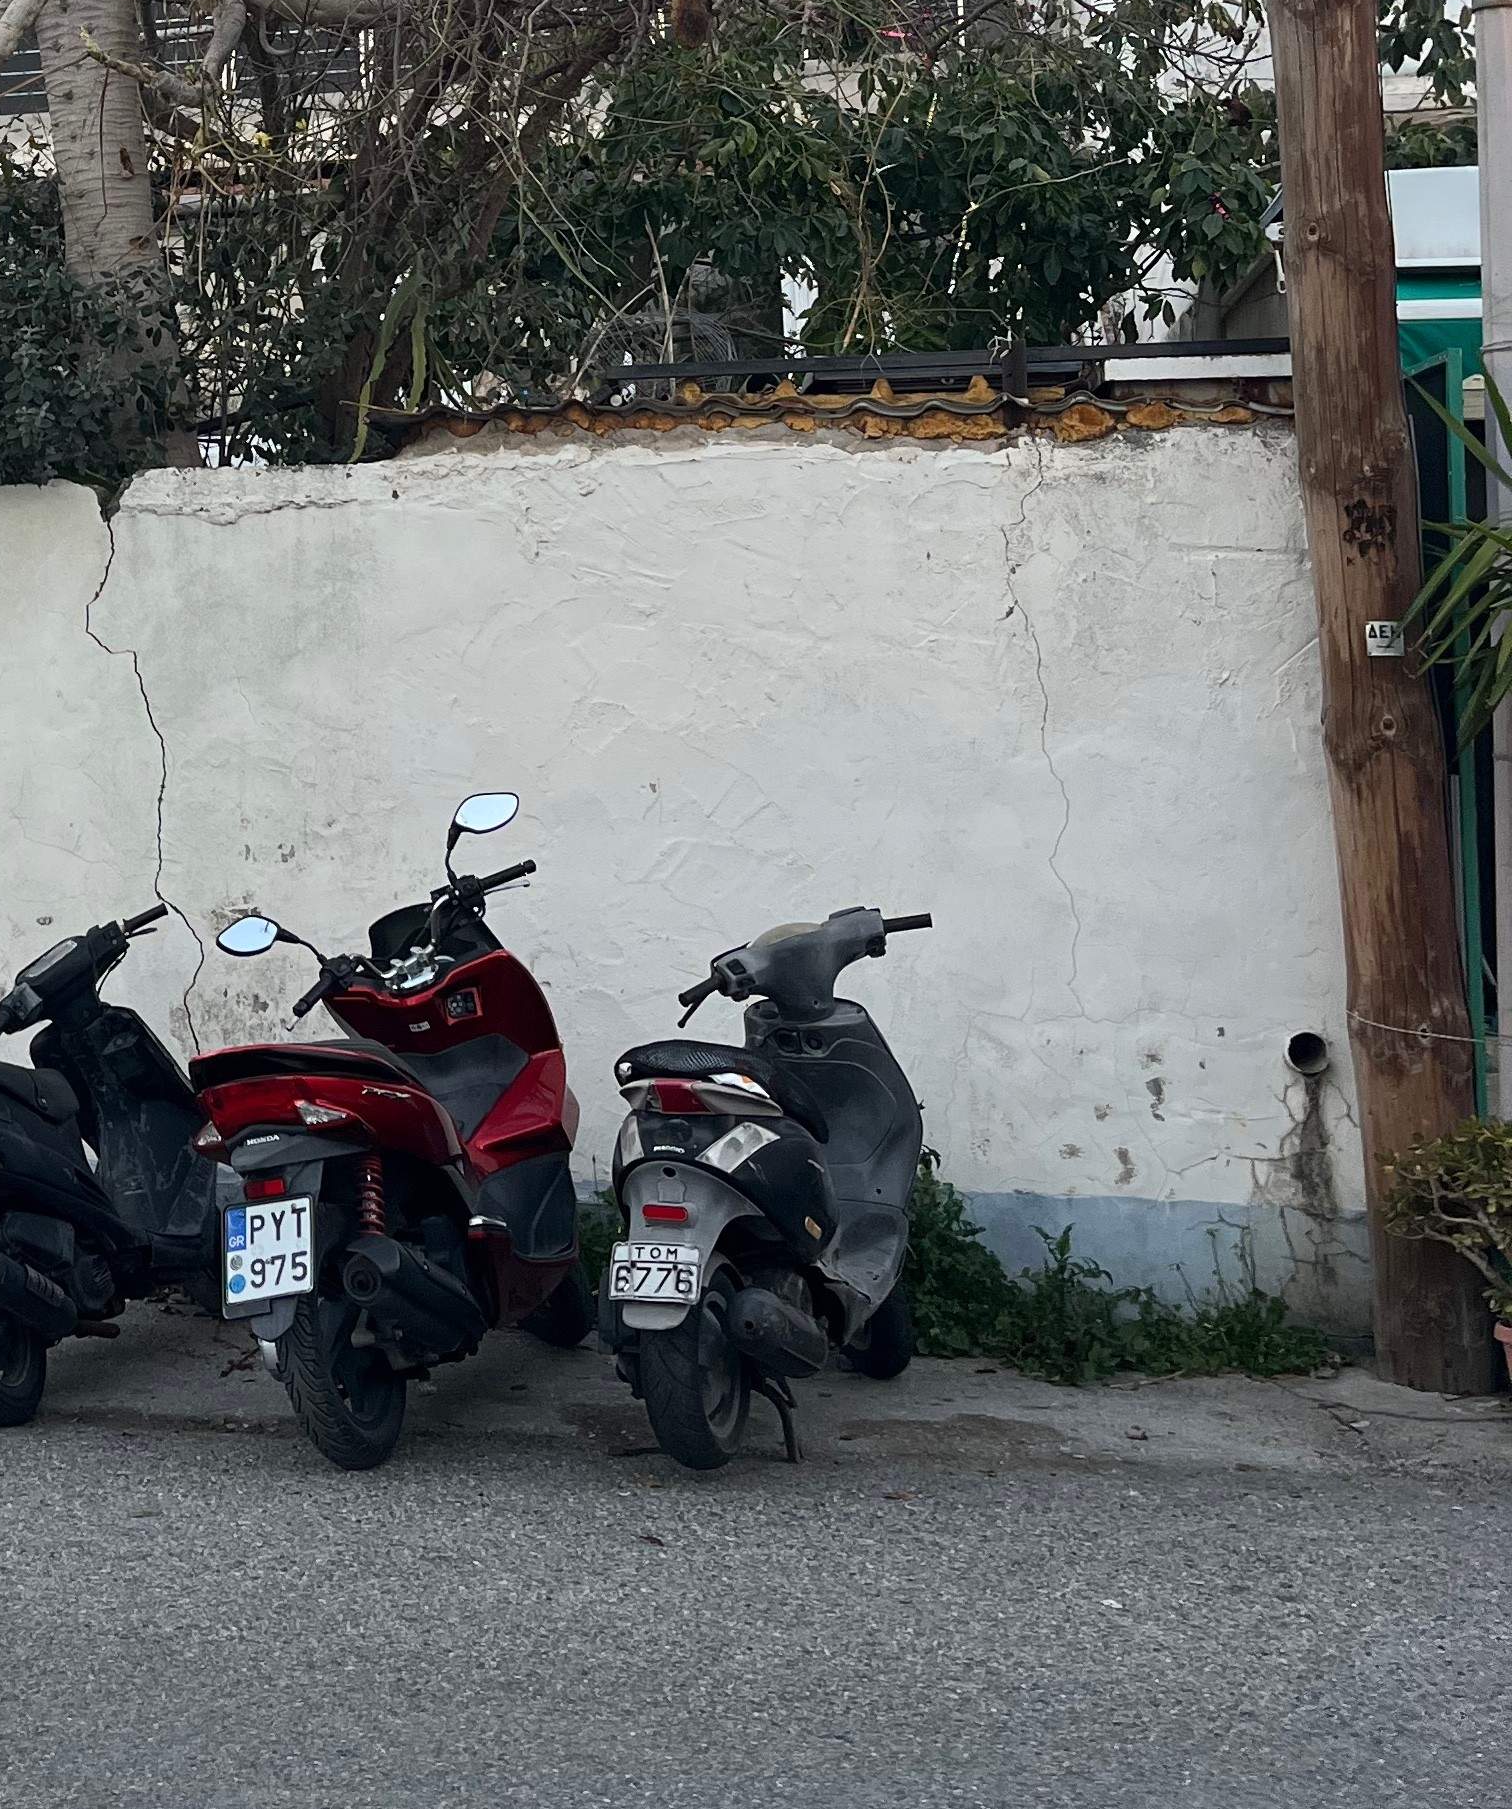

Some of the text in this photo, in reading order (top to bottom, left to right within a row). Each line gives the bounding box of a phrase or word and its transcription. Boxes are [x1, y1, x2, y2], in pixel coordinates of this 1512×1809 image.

[246, 1134, 280, 1146] HONDA
[250, 1206, 307, 1245] PYT
[228, 1235, 245, 1248] GR
[634, 1247, 678, 1261] TOM
[250, 1250, 308, 1289] 975
[615, 1265, 694, 1294] 6776
